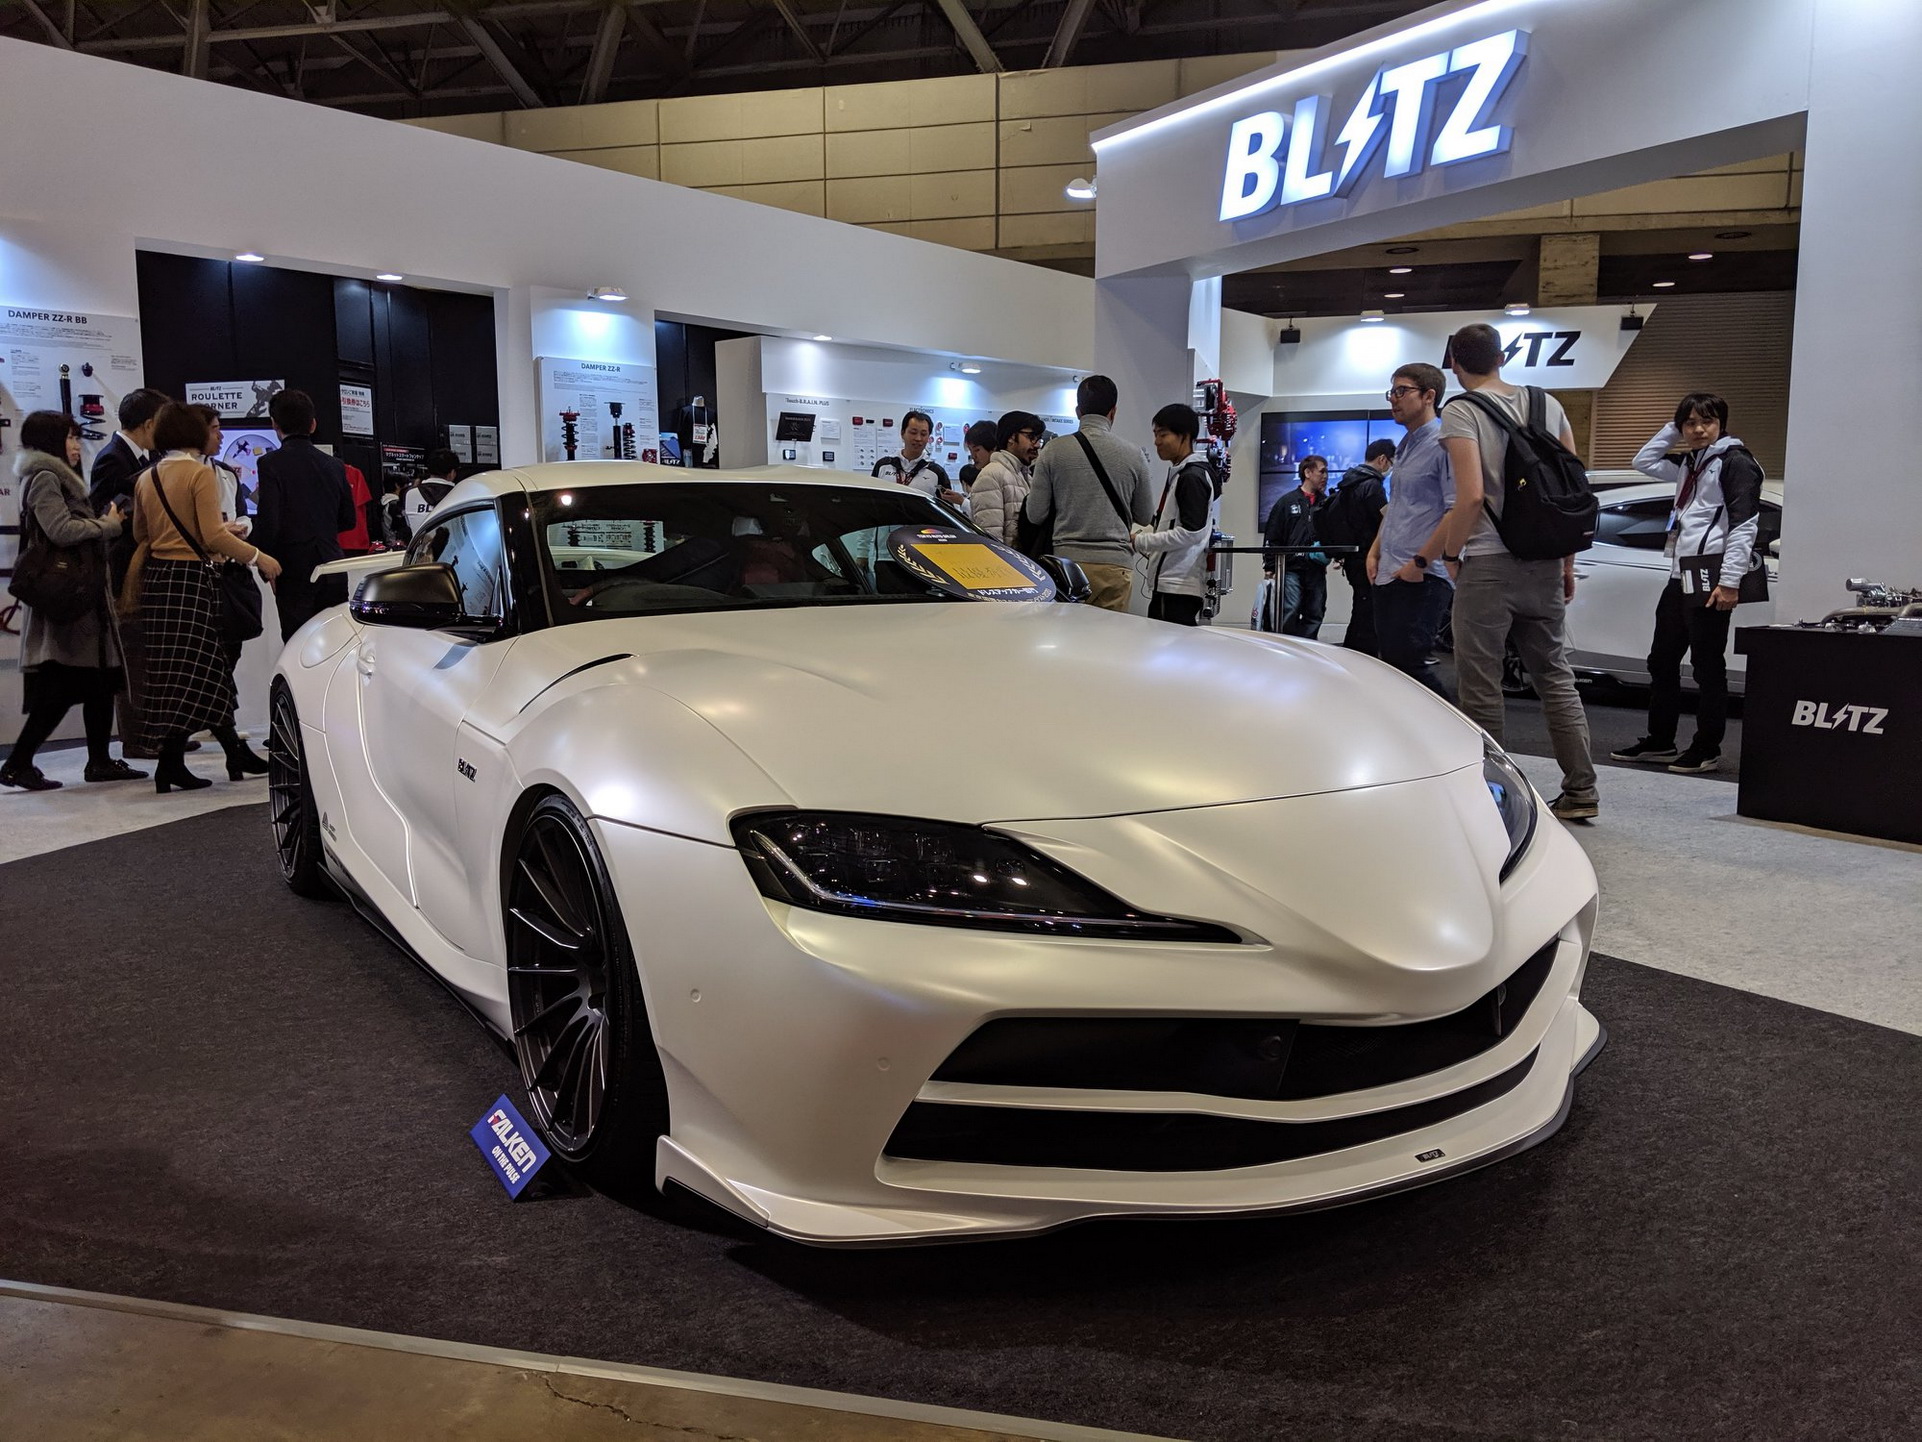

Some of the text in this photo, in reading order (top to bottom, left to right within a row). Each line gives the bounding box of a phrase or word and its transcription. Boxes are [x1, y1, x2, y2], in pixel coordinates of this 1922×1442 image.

[1219, 29, 1530, 222] BLITZ
[8, 310, 88, 324] DAMPER ZZ-R BB
[581, 363, 607, 371] DAMPER
[191, 392, 243, 401] ROULETTE
[204, 402, 238, 410] ORNER
[1791, 699, 1889, 735] BLITZ
[487, 1109, 537, 1174] FALKEN
[491, 1145, 521, 1185] ON THE PULSE
